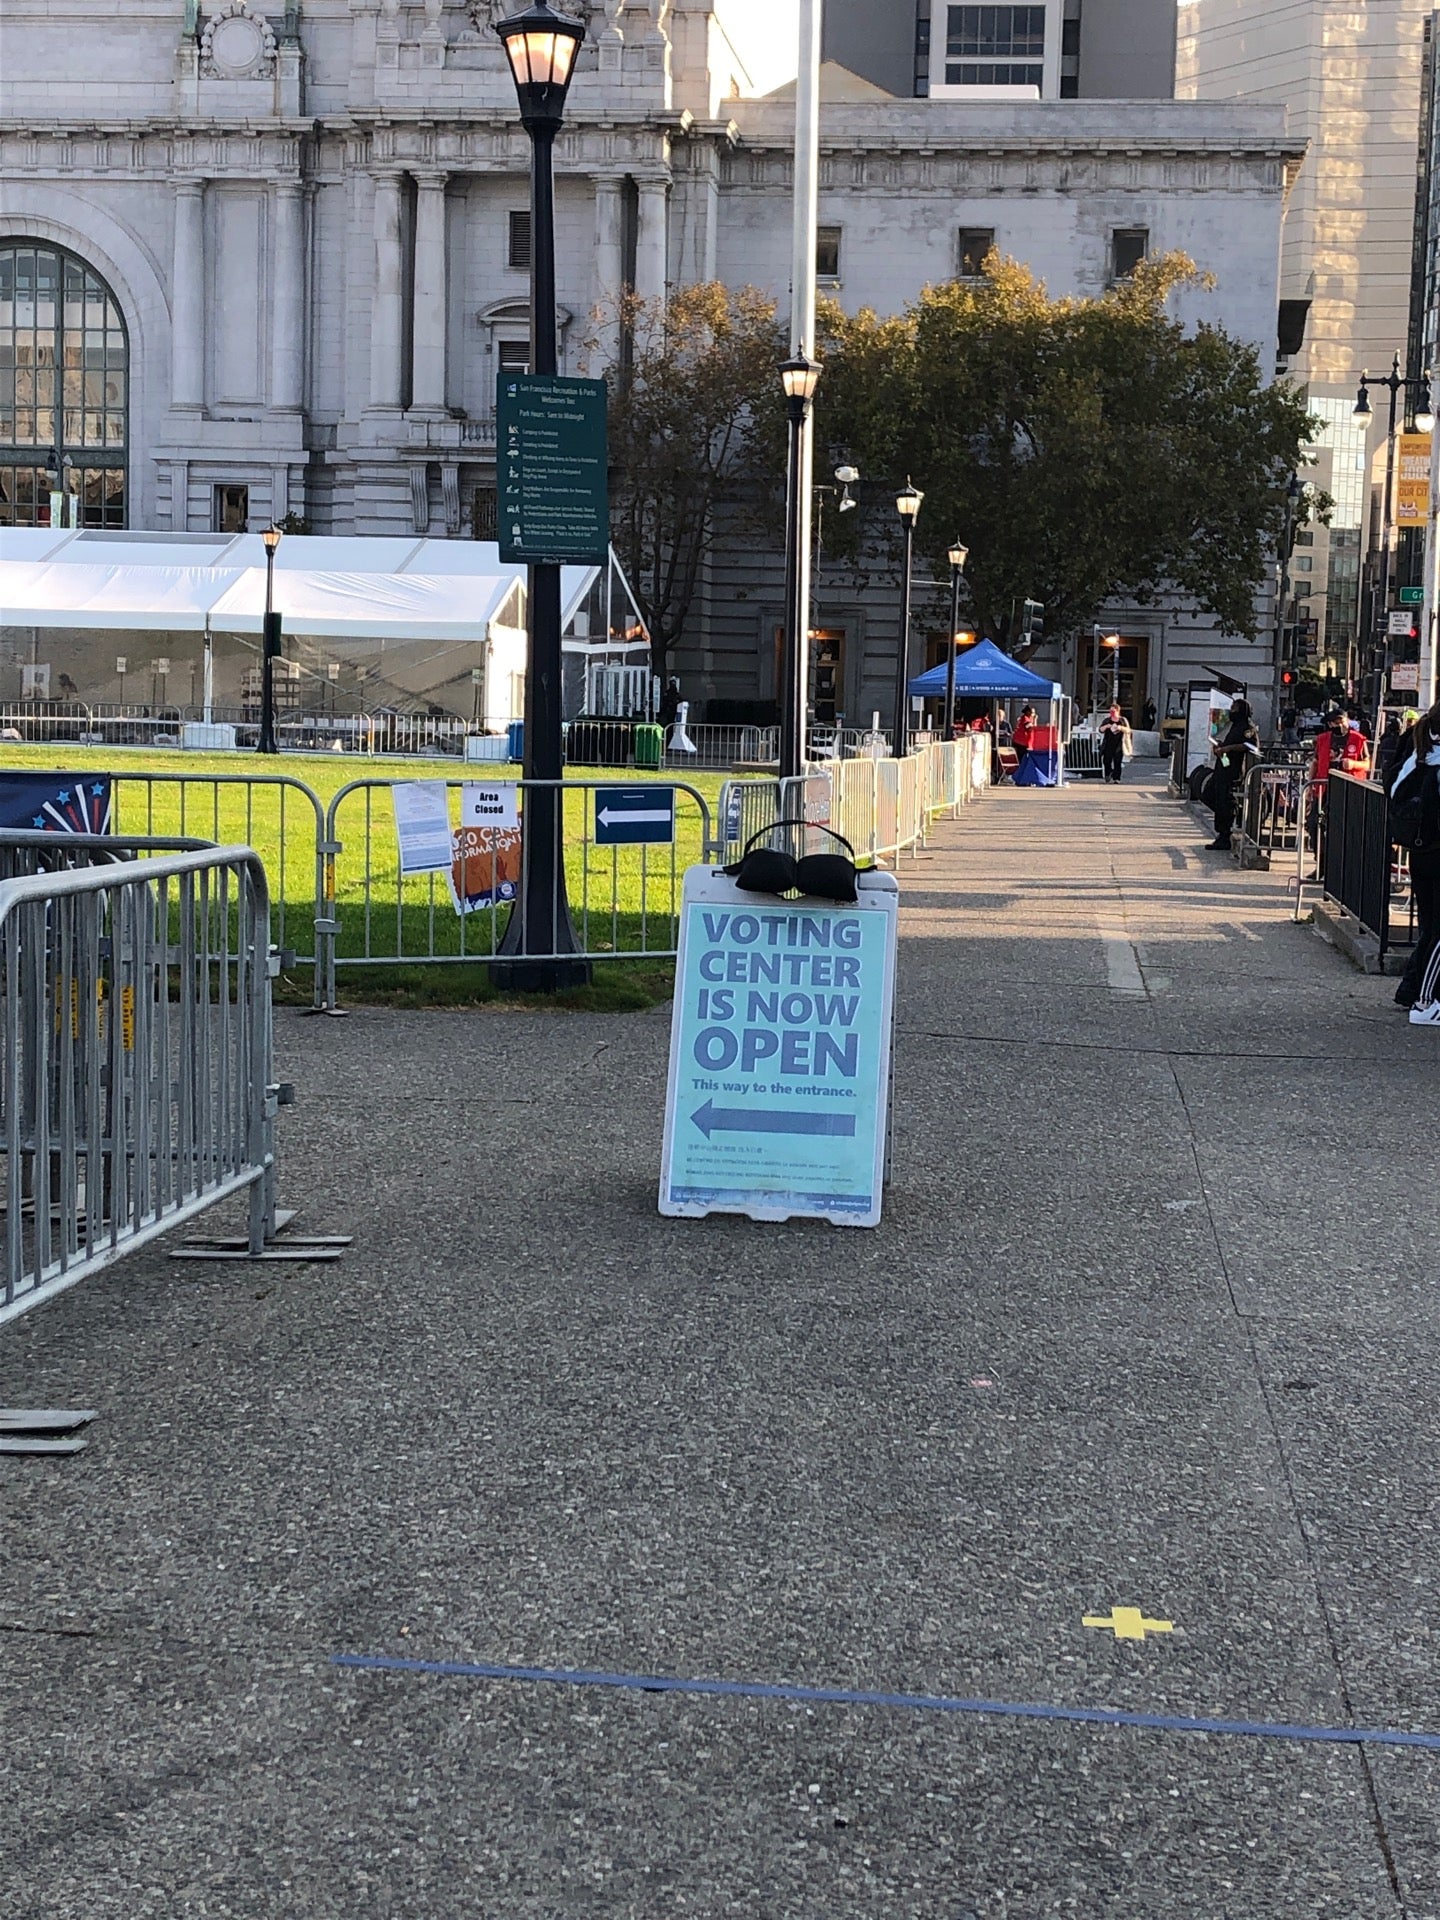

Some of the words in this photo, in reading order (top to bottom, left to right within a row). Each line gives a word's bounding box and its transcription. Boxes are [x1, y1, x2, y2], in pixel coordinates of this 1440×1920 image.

[1400, 456, 1431, 466] CREATIN
[1416, 487, 1428, 497] CIT
[479, 792, 499, 801] Area
[474, 804, 504, 814] Closed
[702, 913, 862, 950] VOTING
[699, 950, 861, 988] CENTER
[697, 988, 735, 1021] IS
[747, 990, 861, 1027] NOW
[693, 1026, 860, 1078] OPEN
[692, 1078, 719, 1091] This
[723, 1082, 750, 1095] way
[753, 1082, 767, 1093] to
[771, 1083, 792, 1095] the
[795, 1085, 857, 1098] entrance.
